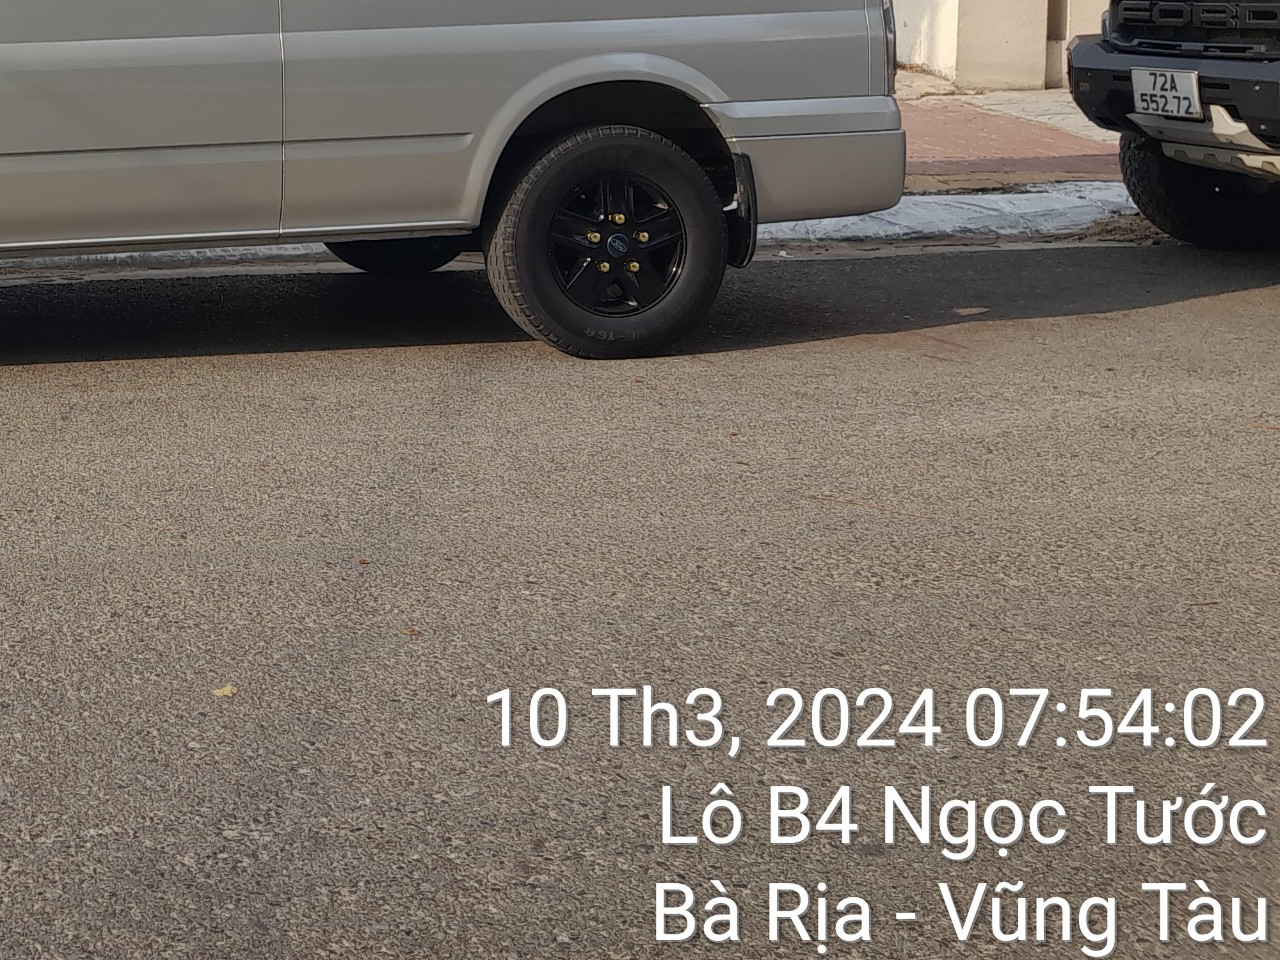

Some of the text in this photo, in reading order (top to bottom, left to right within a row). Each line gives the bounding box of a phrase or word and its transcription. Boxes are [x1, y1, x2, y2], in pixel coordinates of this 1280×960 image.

[1118, 0, 1280, 29] FORD
[1149, 72, 1178, 92] 72A
[1140, 93, 1194, 115] 552.72
